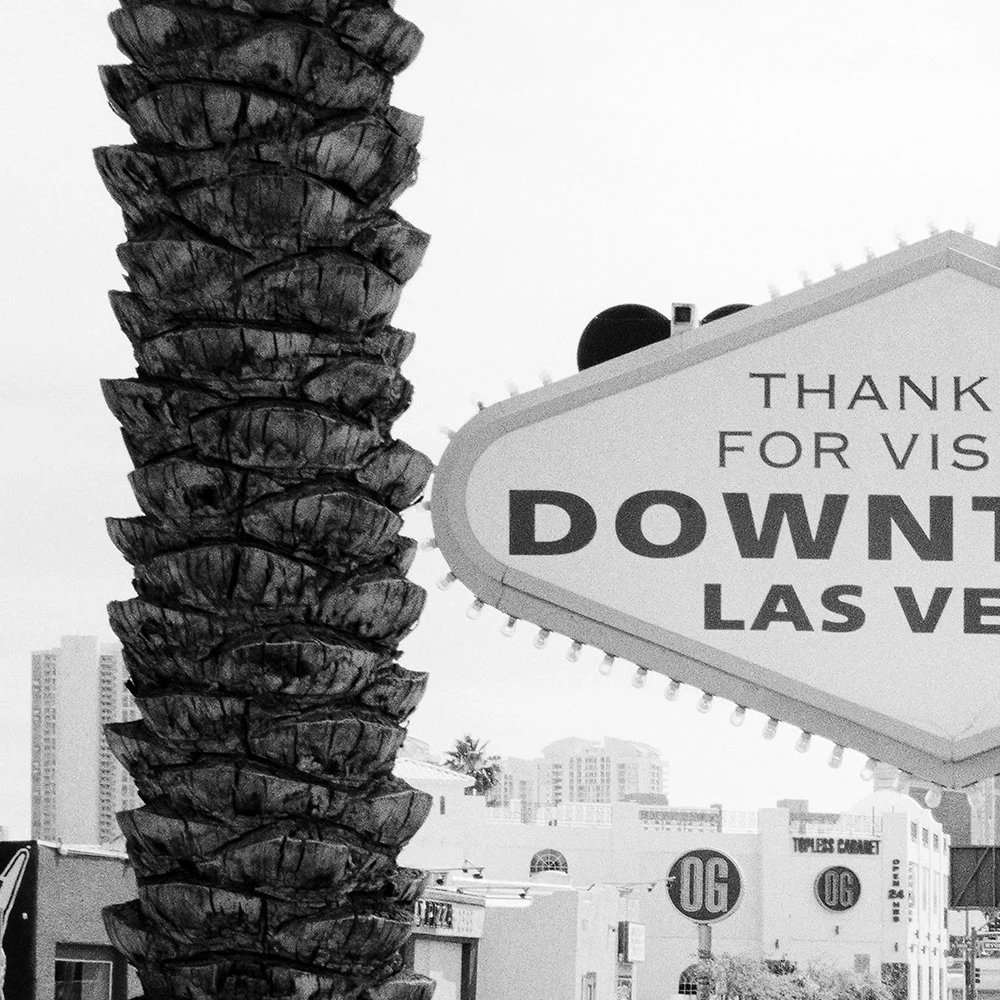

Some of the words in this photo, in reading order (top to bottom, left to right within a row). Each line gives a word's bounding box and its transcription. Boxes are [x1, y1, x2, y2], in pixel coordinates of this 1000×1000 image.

[748, 373, 991, 412] THANK
[718, 430, 851, 469] FOR
[704, 583, 866, 633] LAS
[792, 837, 835, 854] TOPLESS
[837, 838, 881, 855] CABARET
[680, 856, 728, 913] OG
[824, 870, 854, 907] OG
[888, 889, 905, 900] 24
